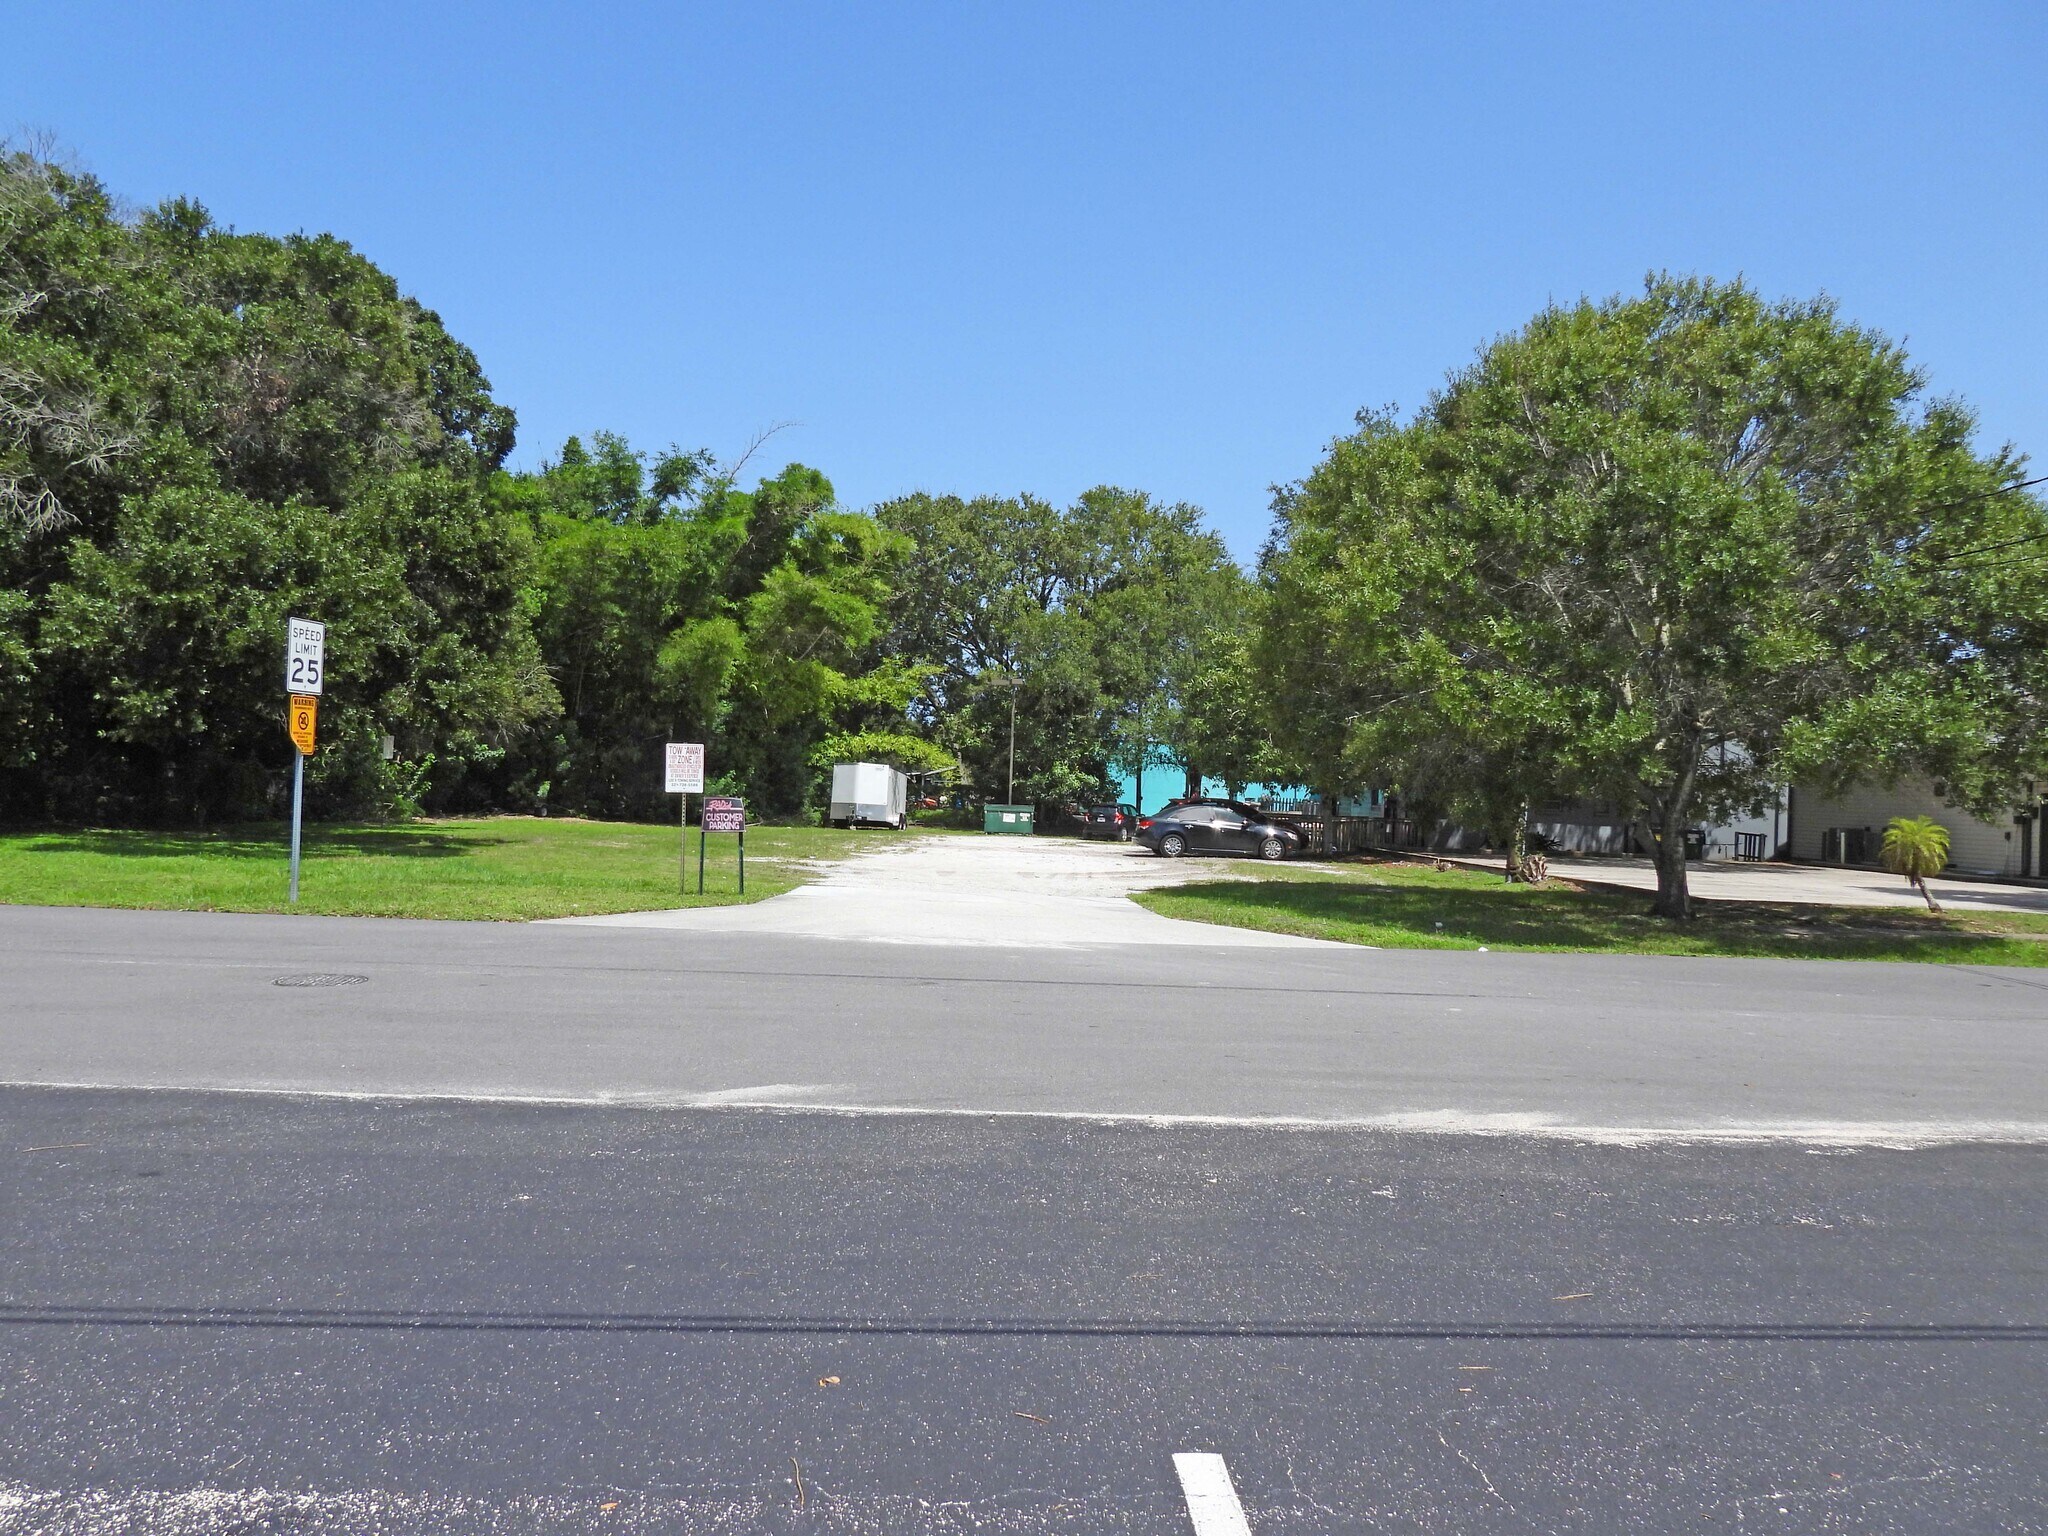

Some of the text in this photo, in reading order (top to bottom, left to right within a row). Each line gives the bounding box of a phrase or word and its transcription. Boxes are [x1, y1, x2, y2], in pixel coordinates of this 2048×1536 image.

[293, 627, 322, 641] SPEED
[295, 642, 318, 655] LIMIT
[292, 657, 319, 684] 25
[669, 746, 702, 755] TOW AWAY
[677, 755, 693, 764] ZONE
[706, 813, 743, 821] CUSTOMER
[709, 821, 740, 829] PARKING
